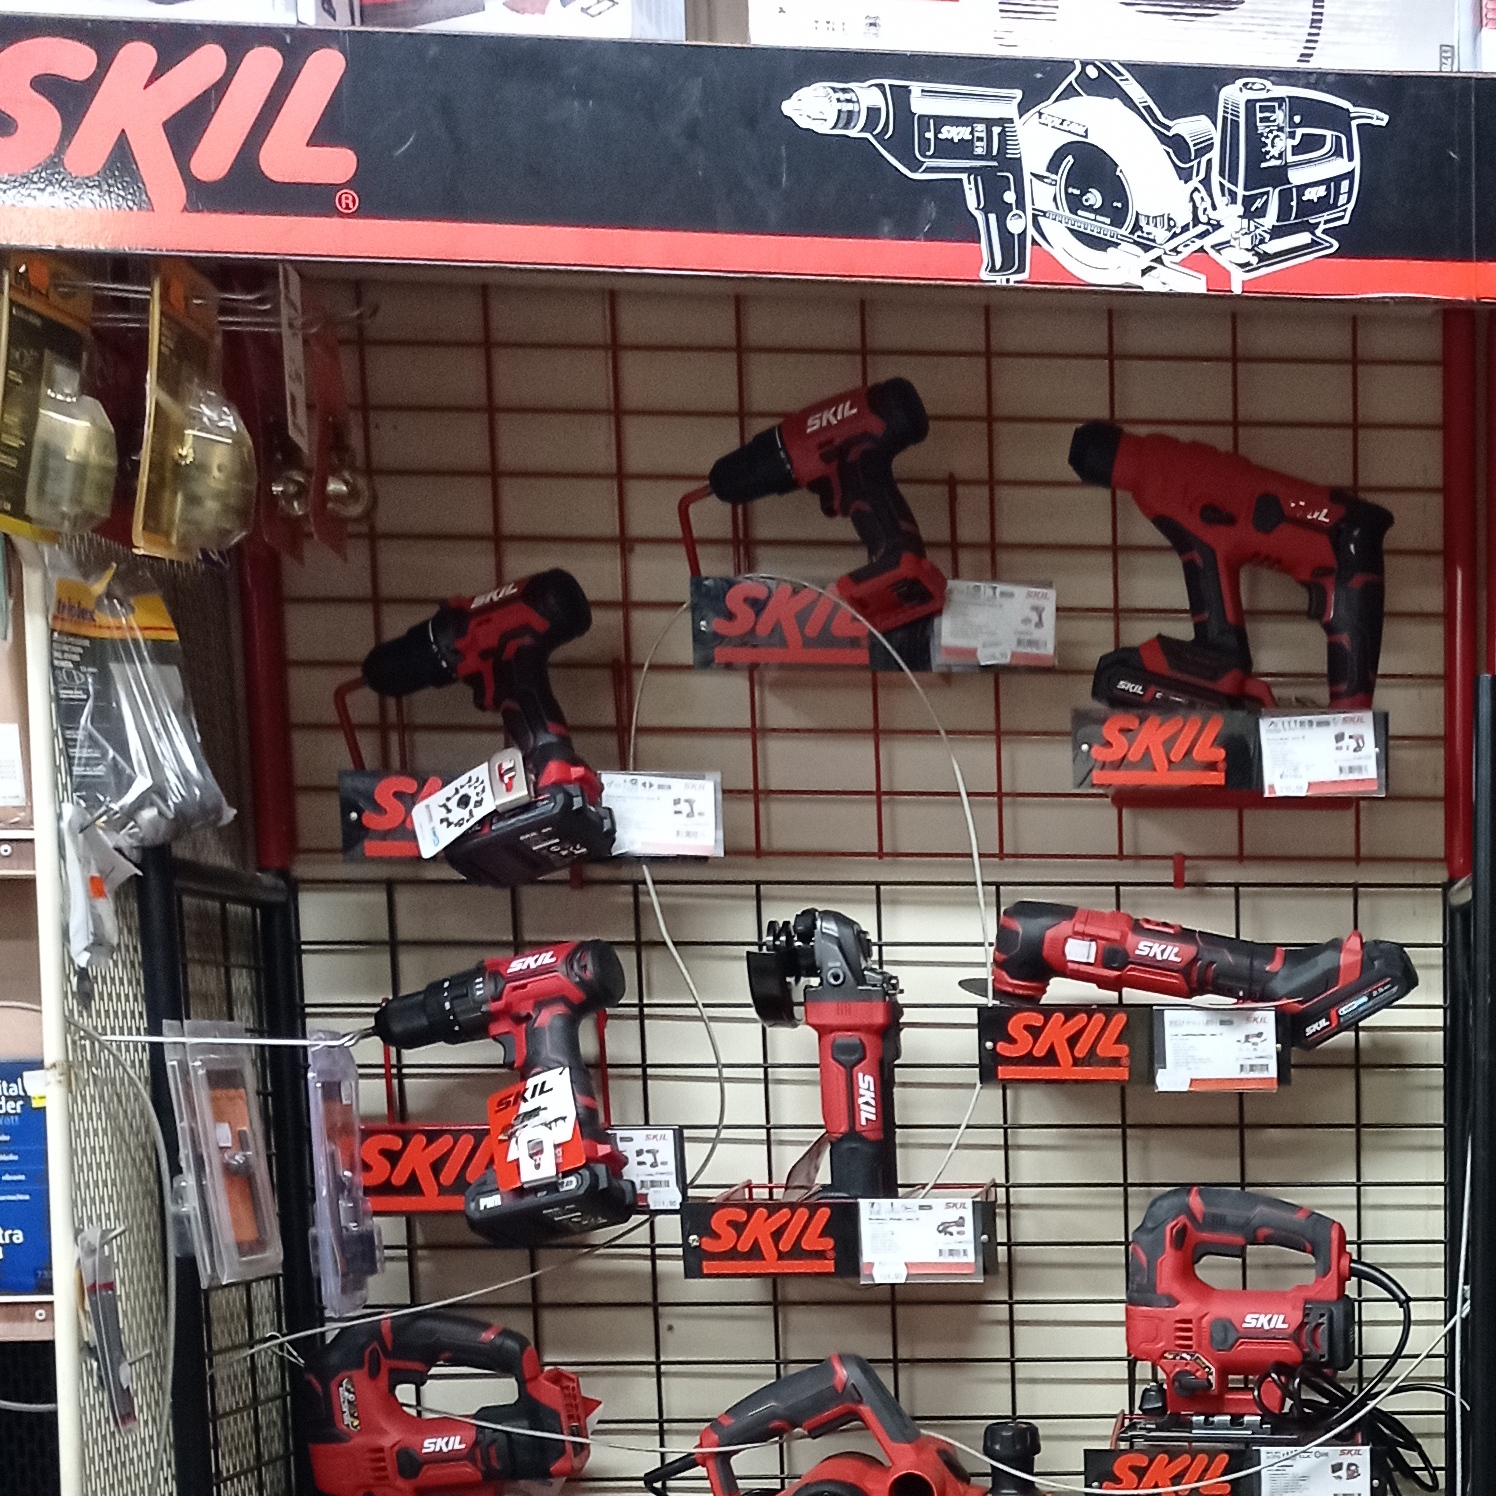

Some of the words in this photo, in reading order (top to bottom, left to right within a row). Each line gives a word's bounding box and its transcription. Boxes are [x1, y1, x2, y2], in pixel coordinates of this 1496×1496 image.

[0, 36, 357, 213] SKIL
[938, 125, 972, 142] SKIL
[806, 404, 858, 434] SKIL
[1117, 681, 1144, 695] SKIL
[1091, 714, 1226, 775] SKIL
[507, 951, 557, 973] SKIL
[1135, 941, 1182, 963] SKIL
[1305, 1018, 1330, 1037] SKIL
[996, 1012, 1129, 1067] SKIL
[497, 1081, 554, 1113] SKIL
[858, 1072, 876, 1126] SKIL
[645, 1133, 668, 1141] SKIL
[945, 1202, 968, 1210] SKIL
[701, 1207, 835, 1260] SKIL
[1242, 1313, 1289, 1330] SKIL
[422, 1435, 466, 1454] SKIL
